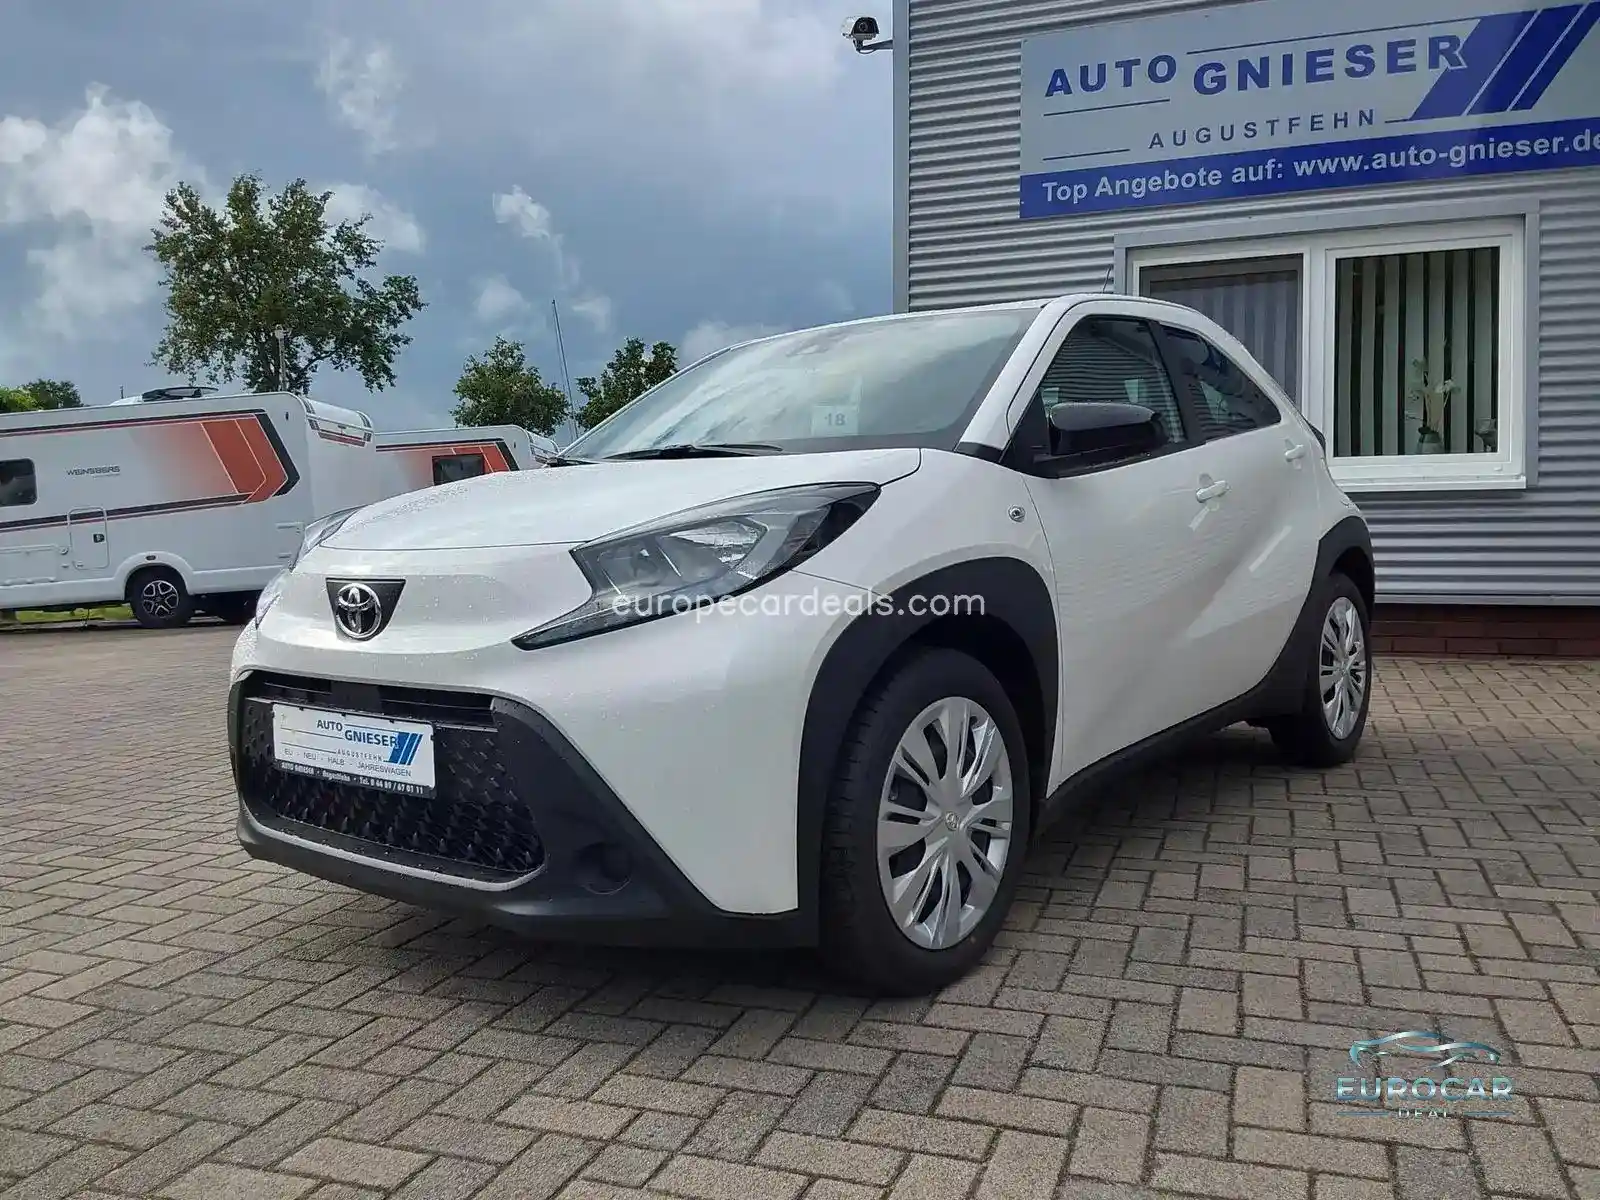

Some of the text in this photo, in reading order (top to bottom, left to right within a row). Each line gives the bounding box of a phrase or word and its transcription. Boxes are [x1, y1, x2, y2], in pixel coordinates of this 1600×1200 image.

[1044, 54, 1177, 98] AUTO
[1193, 34, 1467, 95] GNIESER
[1148, 109, 1375, 150] AUGUSTFEHN
[1042, 182, 1088, 205] Top
[1095, 167, 1222, 199] Angebote
[1232, 158, 1284, 184] auf:
[316, 719, 343, 732] AUTO
[344, 731, 399, 747] GNIESER
[328, 757, 345, 766] HALB
[357, 762, 412, 777] JAHRESWAGEN
